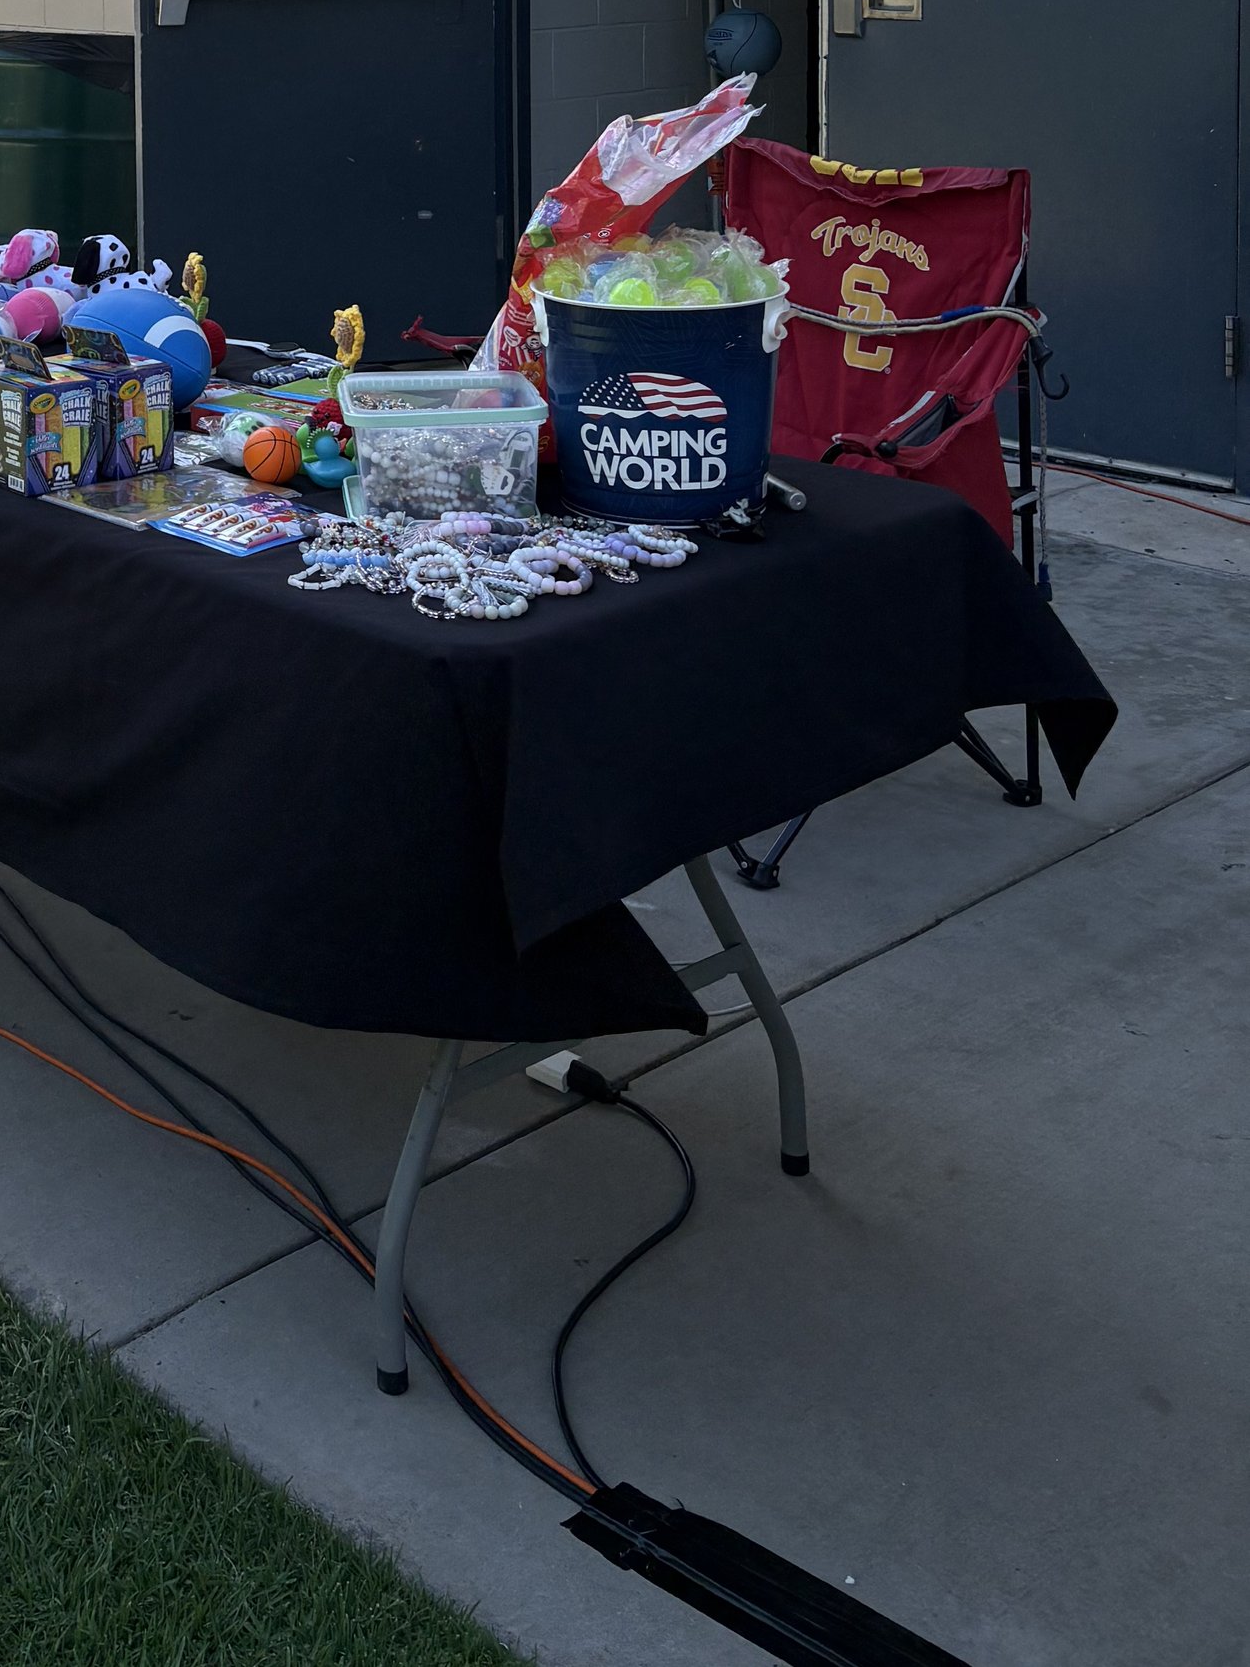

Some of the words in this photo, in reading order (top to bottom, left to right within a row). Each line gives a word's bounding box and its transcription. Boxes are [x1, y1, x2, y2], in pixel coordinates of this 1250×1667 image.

[811, 216, 930, 271] Trojans
[146, 380, 170, 395] CHALK
[3, 398, 21, 413] CHALK
[62, 395, 91, 411] CHALK
[148, 393, 169, 407] CRAIE
[63, 408, 90, 422] CRAIE
[580, 423, 727, 457] CAMPING
[141, 447, 153, 464] 24
[55, 464, 70, 480] 24
[583, 449, 727, 491] WORLD
